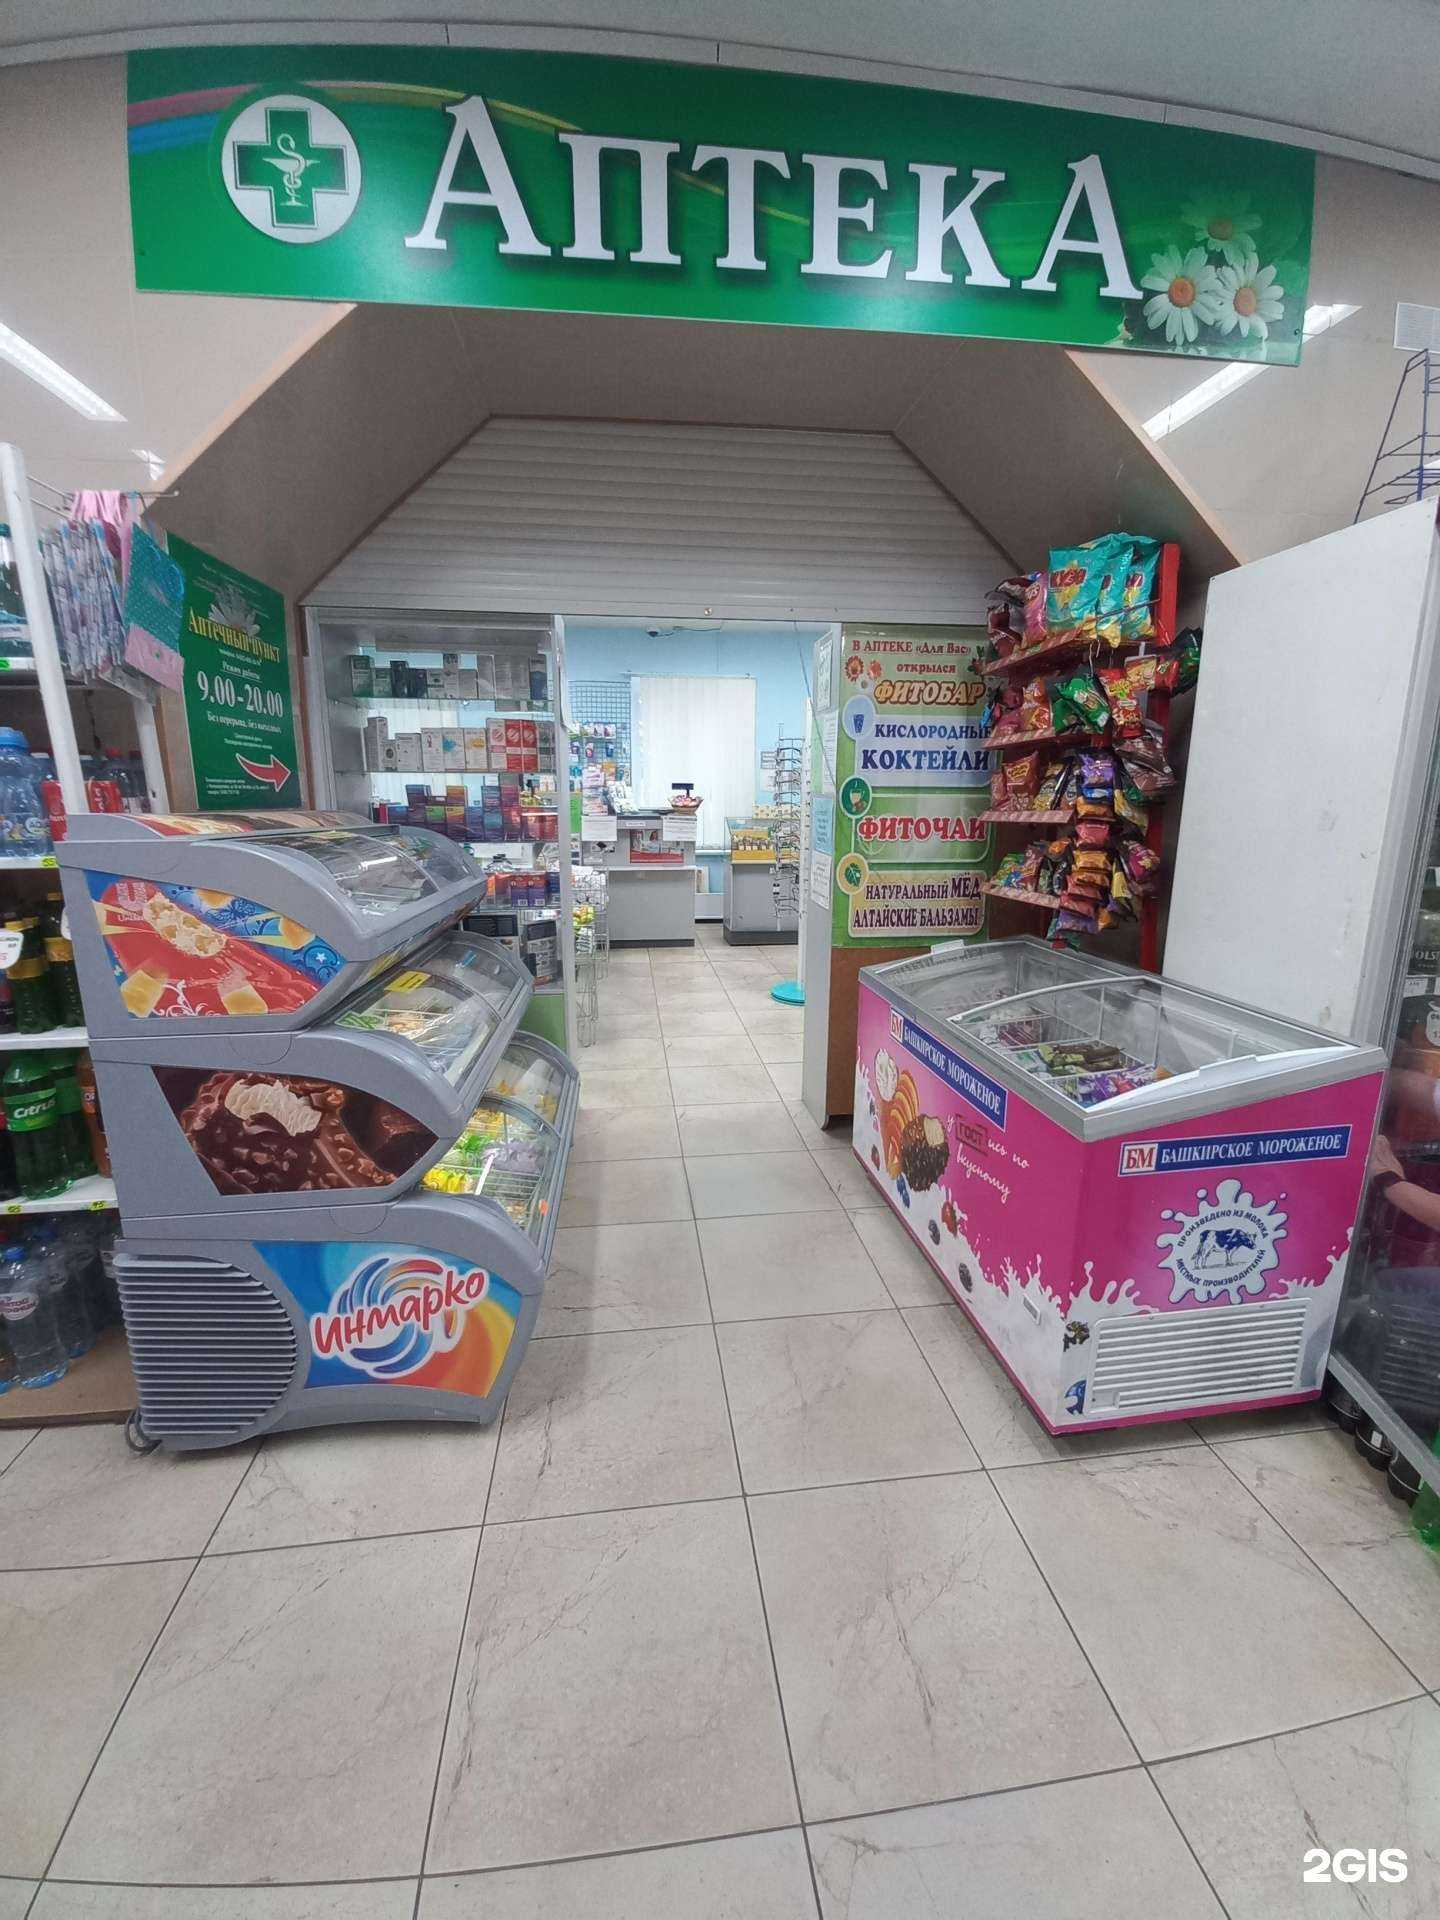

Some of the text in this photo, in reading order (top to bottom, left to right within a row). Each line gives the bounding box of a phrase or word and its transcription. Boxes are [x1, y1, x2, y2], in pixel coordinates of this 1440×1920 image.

[404, 94, 1144, 300] АПТЕКА
[852, 640, 861, 652] В
[863, 640, 913, 653] АПТЕКЕ
[896, 663, 957, 675] открылся
[874, 680, 986, 705] ФИТОБАР
[861, 745, 990, 770] КОКТЕЙЛИ
[858, 816, 987, 840] ФИТОЧАИ
[866, 872, 981, 900] НАТУРАЛЬНЫЙ МЁД
[853, 904, 980, 928] АЛТАЙСКИЕ БАЛЬЗАМЫ
[904, 1026, 947, 1072] БАШКИРСКОЕ
[947, 1059, 1001, 1116] МОРОЖЕНОЕ
[1124, 1134, 1343, 1170] БМ БАШКИРСКОЕ МОРОЖЕНОЕ
[1177, 1209, 1269, 1247] ПРОИЗВЕДЕНО ИЗ МОЛОКА
[1176, 1258, 1201, 1286] МЕСТНЫХ
